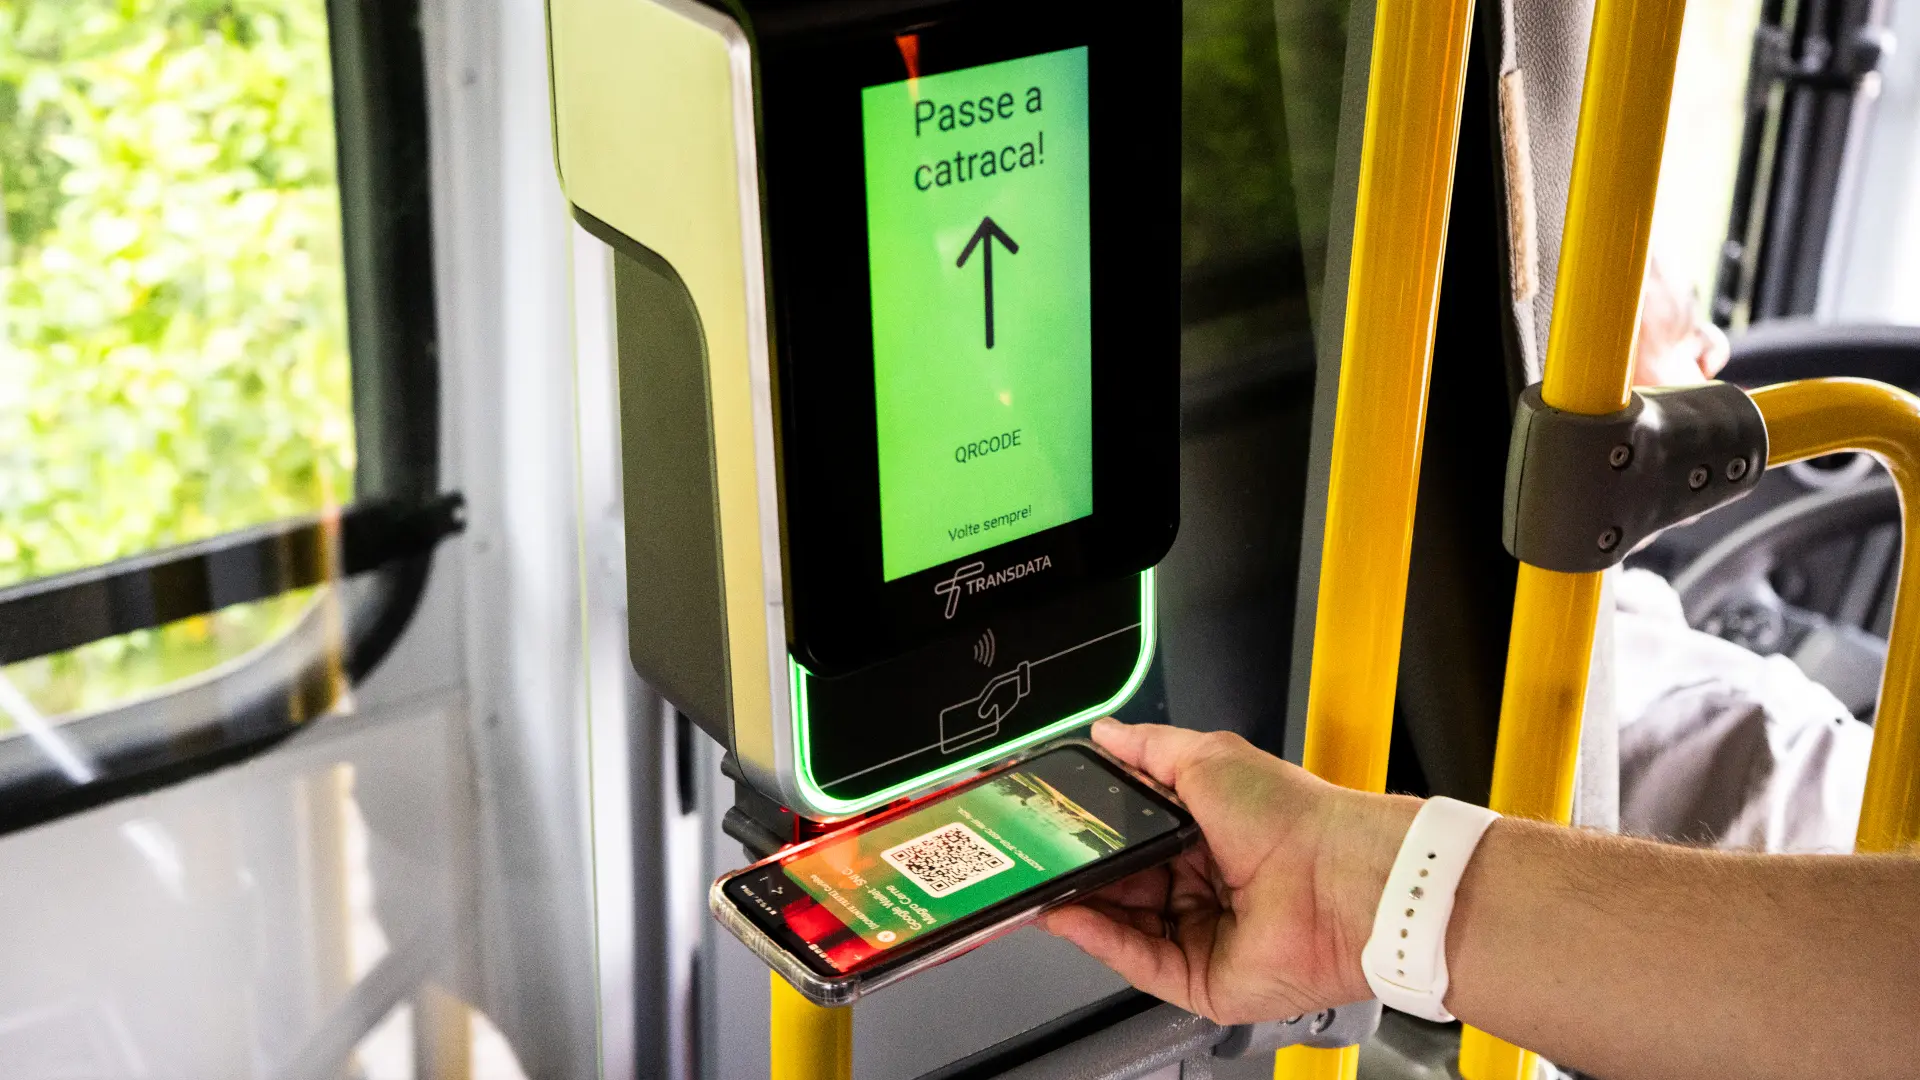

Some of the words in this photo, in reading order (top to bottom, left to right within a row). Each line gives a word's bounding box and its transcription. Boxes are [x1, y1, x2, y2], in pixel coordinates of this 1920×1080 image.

[914, 92, 1014, 138] Passe
[1025, 86, 1042, 114] a
[914, 131, 1045, 192] catraca!
[955, 429, 1022, 464] QRCODE
[948, 524, 980, 541] Volte
[983, 505, 1032, 531] sempre!
[965, 555, 1052, 595] TRANSDATA
[866, 887, 896, 909] Wallet
[891, 906, 923, 931] Google
